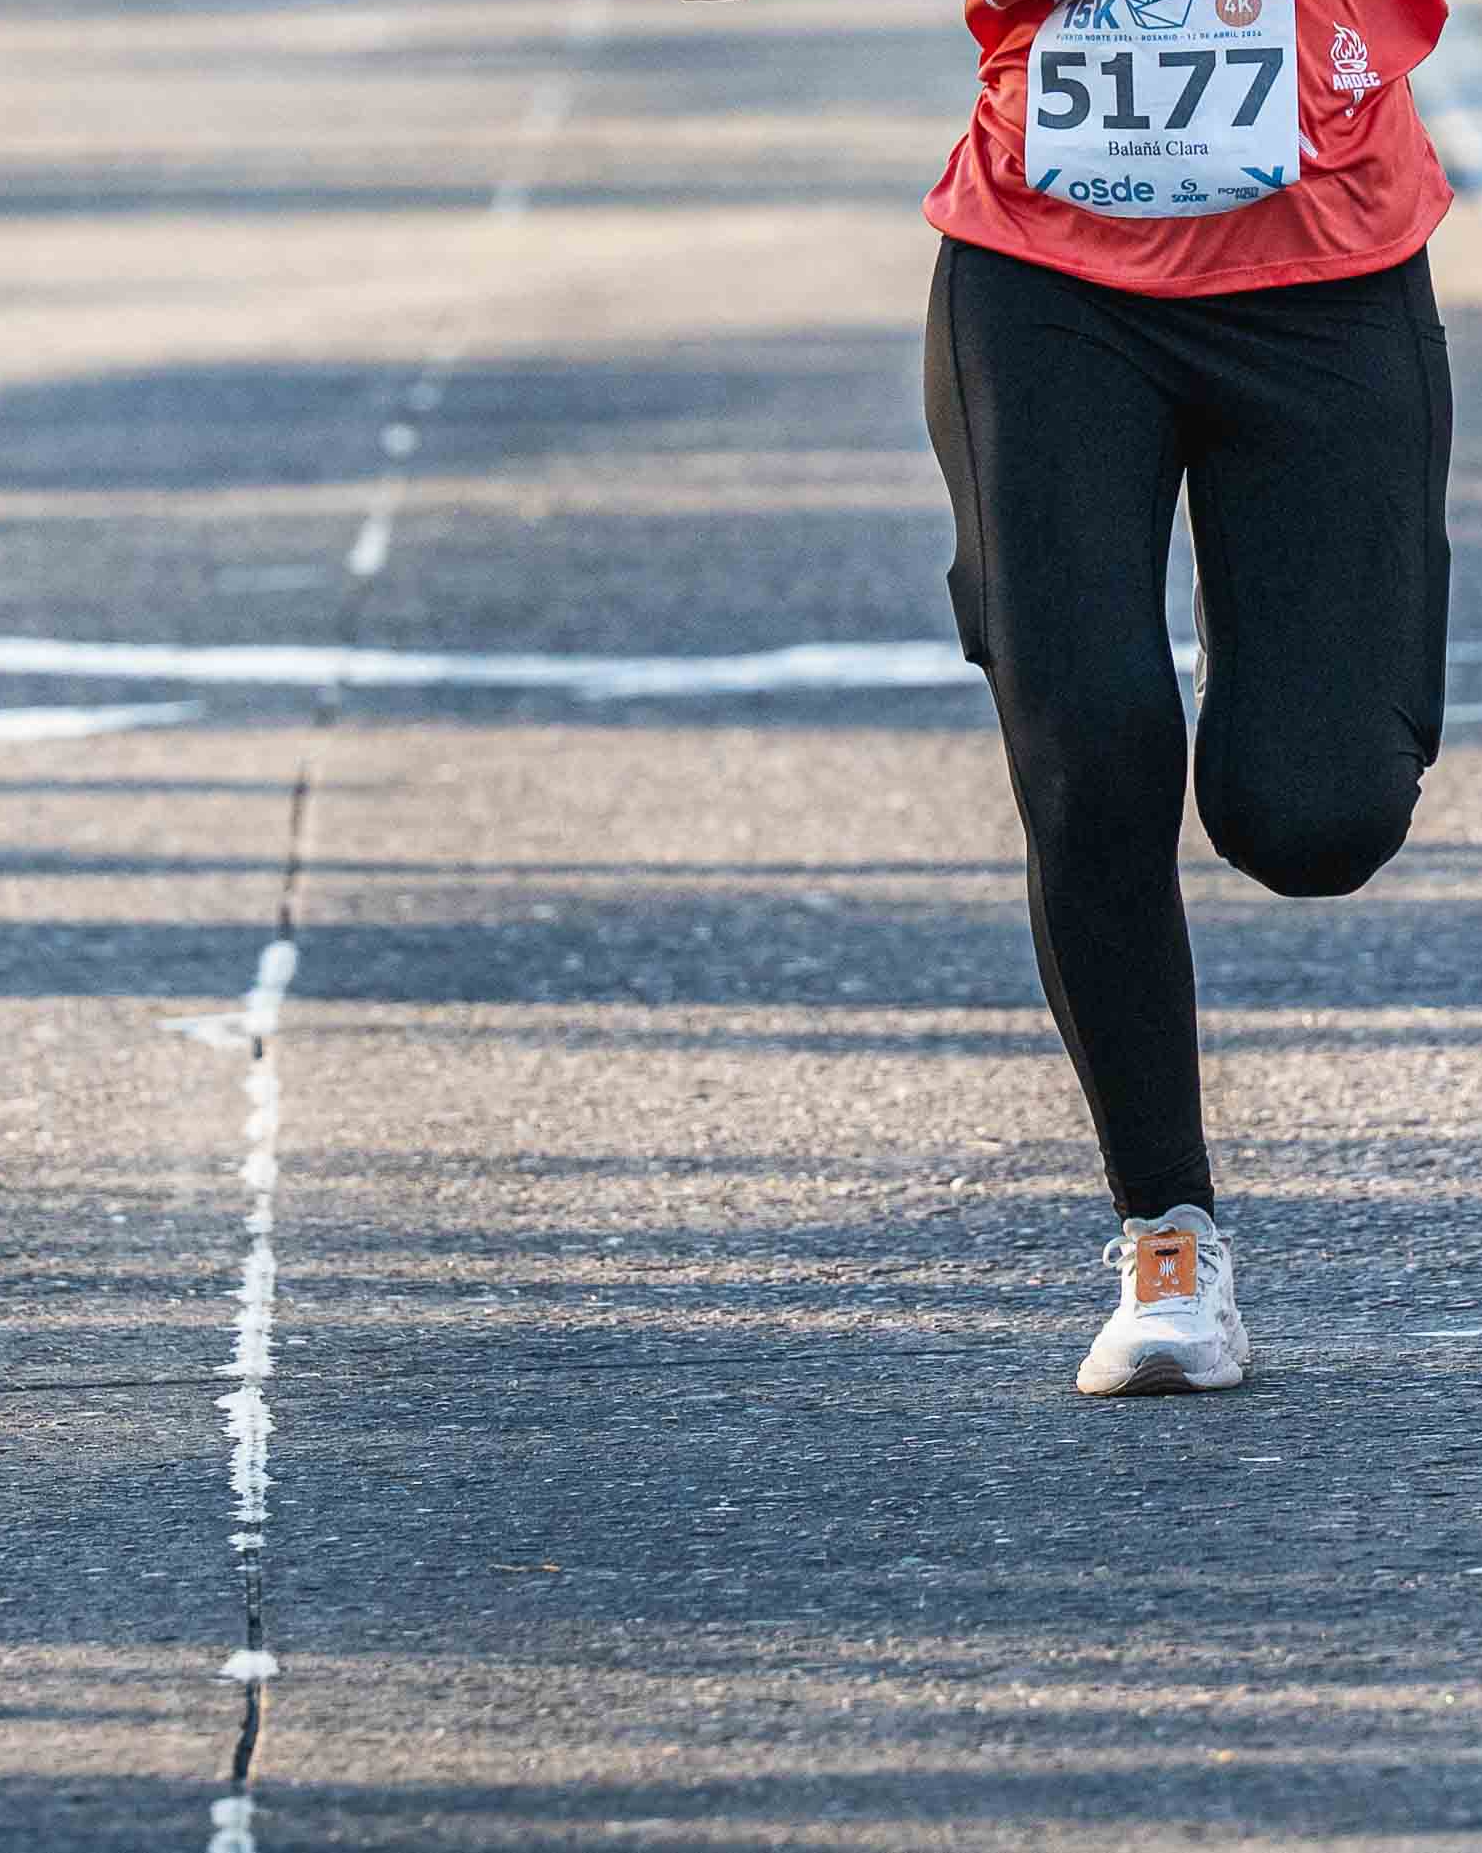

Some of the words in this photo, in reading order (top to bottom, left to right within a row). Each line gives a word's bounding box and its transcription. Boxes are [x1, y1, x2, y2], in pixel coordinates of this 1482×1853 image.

[1085, 33, 1111, 42] NORTE
[1213, 31, 1238, 39] ABRIL
[1037, 47, 1284, 131] 5177
[1108, 140, 1161, 156] Balañá
[1165, 141, 1209, 156] Clara
[1068, 174, 1155, 205] osde
